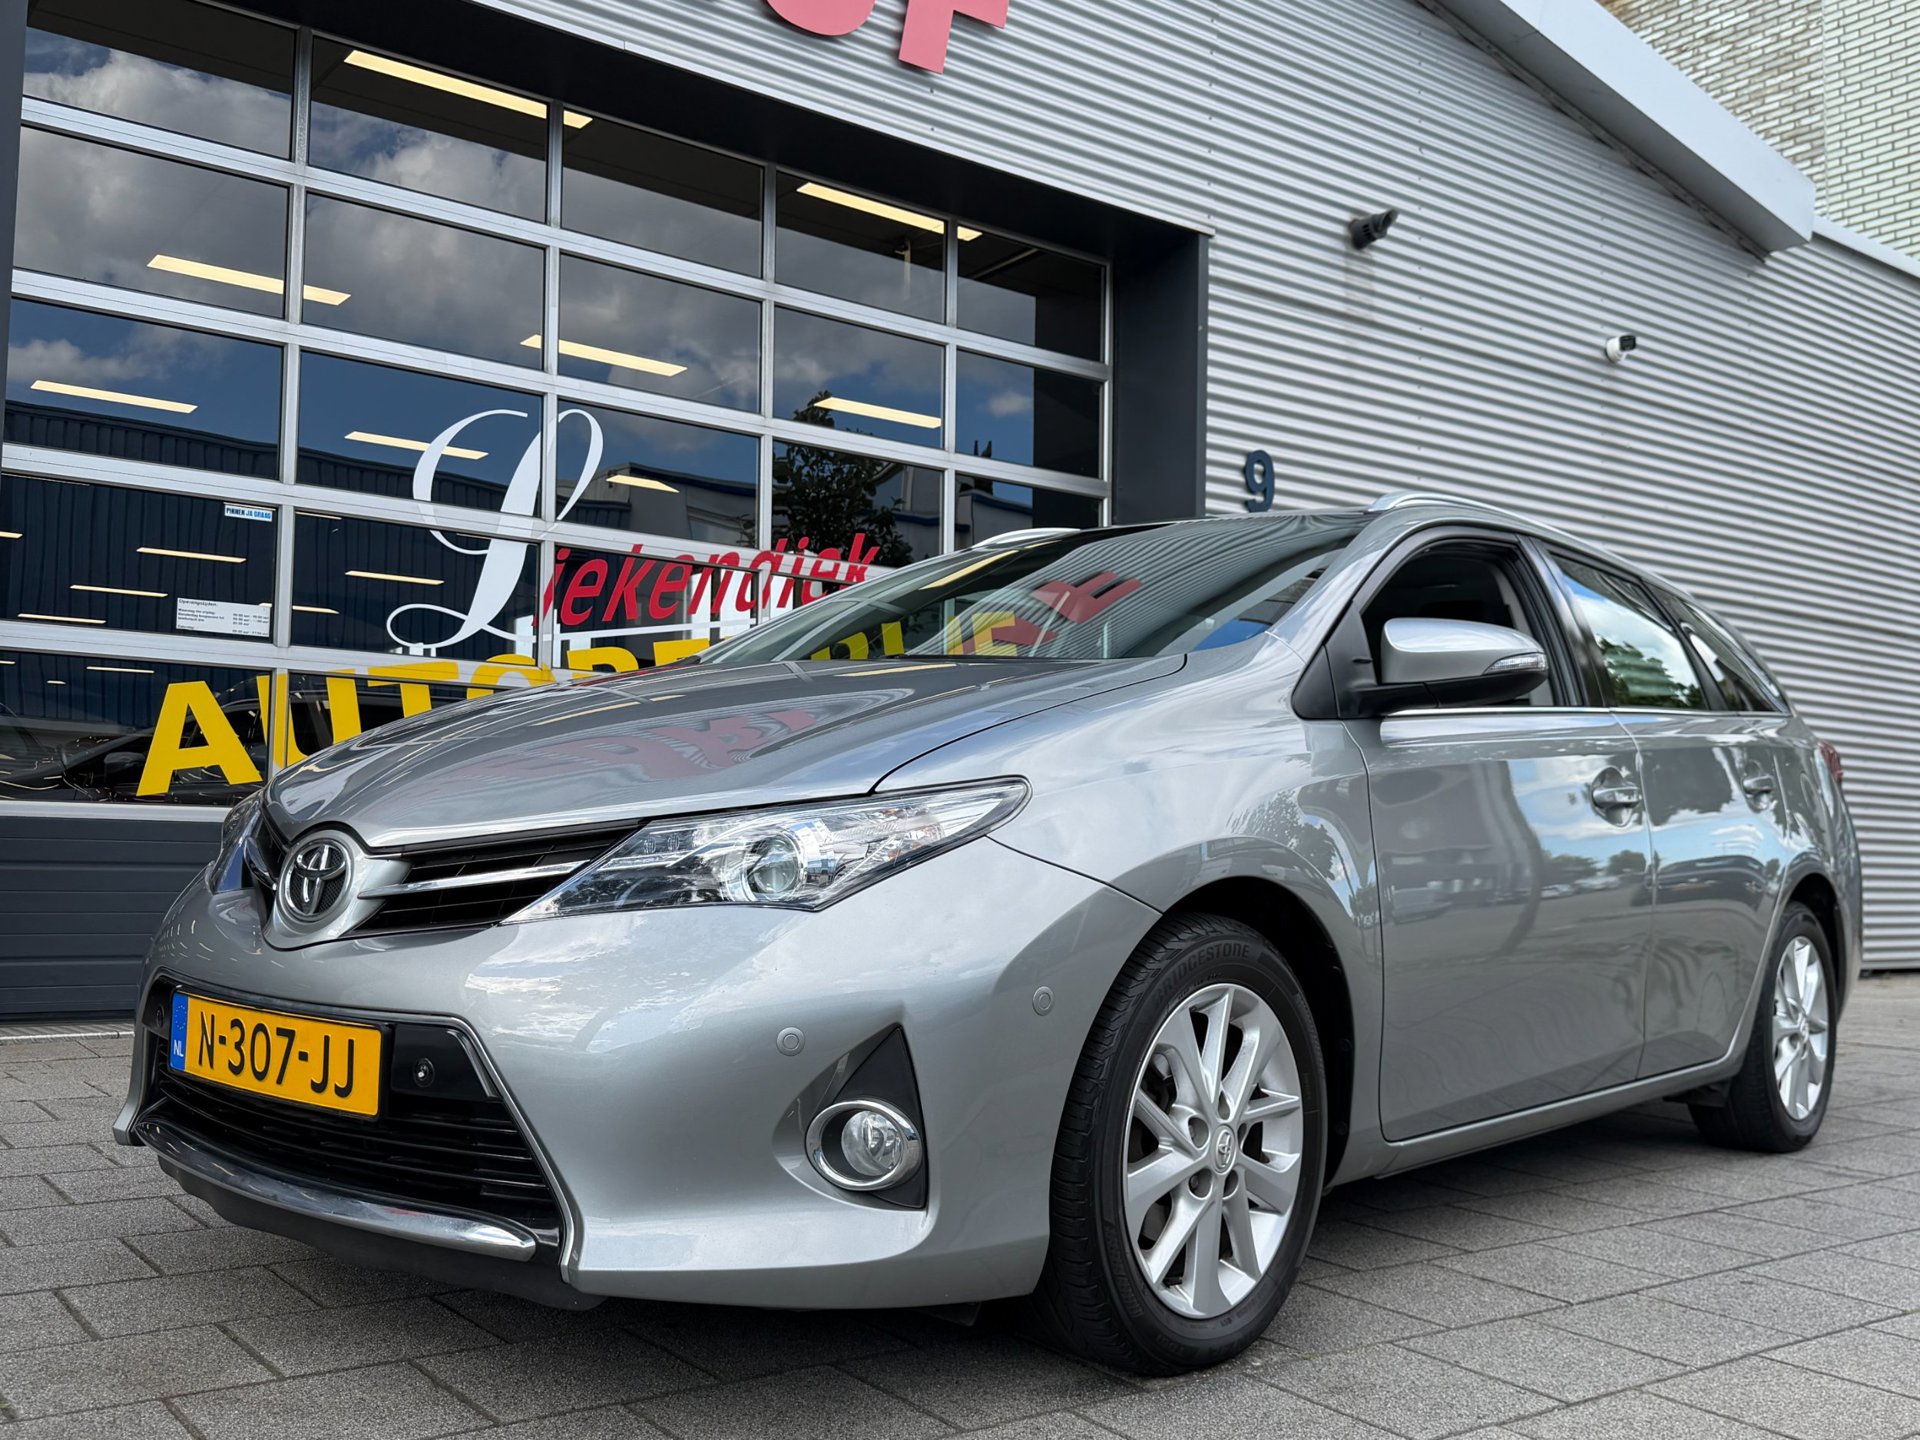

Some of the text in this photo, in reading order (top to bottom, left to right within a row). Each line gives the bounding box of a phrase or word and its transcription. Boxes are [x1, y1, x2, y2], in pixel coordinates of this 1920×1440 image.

[1245, 450, 1275, 512] 9
[226, 507, 245, 516] PINNEN
[173, 1039, 184, 1057] NL
[198, 1011, 355, 1098] N-307-JJ
